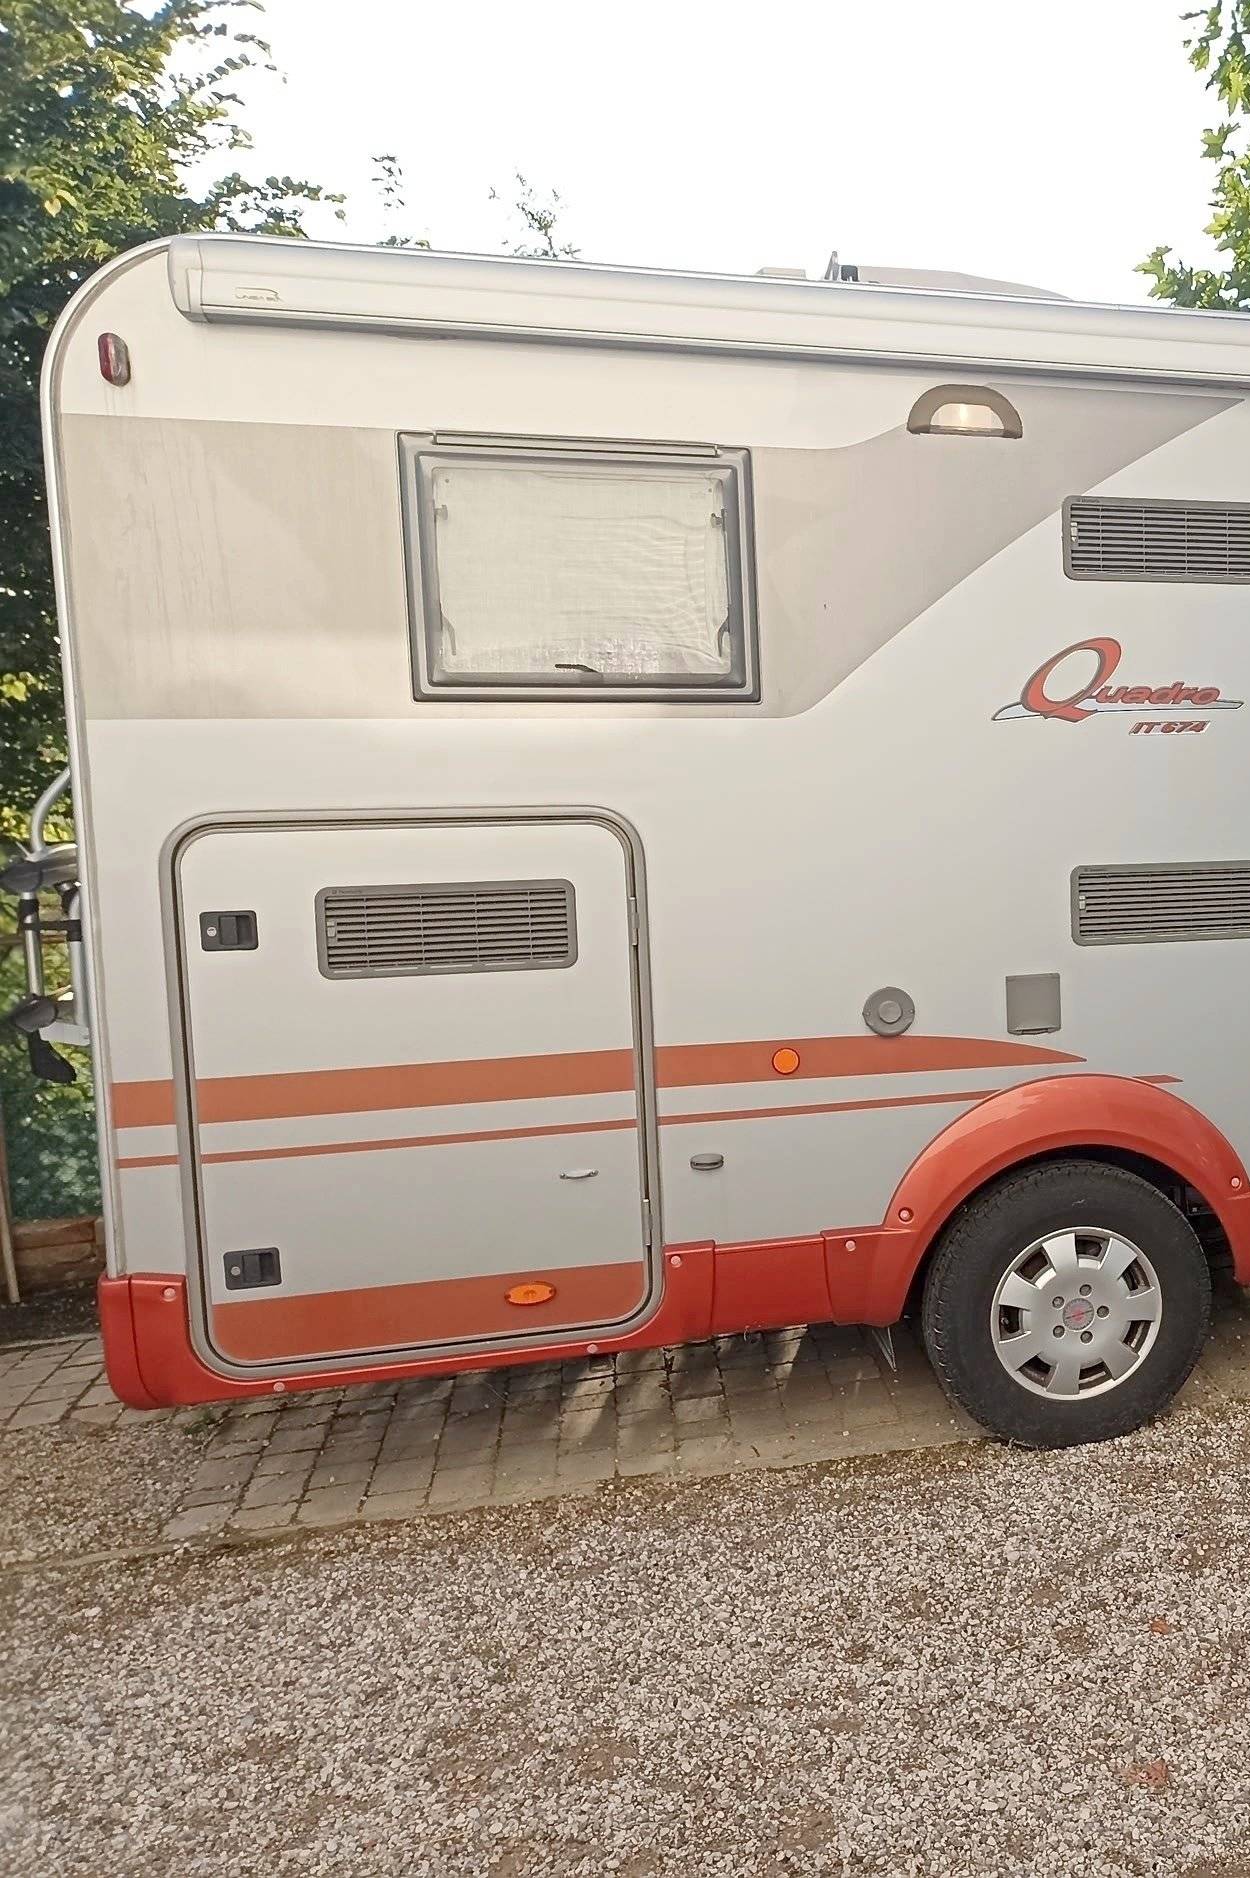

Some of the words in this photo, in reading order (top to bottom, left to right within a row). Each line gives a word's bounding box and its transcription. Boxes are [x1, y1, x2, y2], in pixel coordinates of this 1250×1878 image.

[1020, 637, 1221, 723] Quadro
[1131, 721, 1161, 735] IT
[1161, 721, 1207, 734] 674
